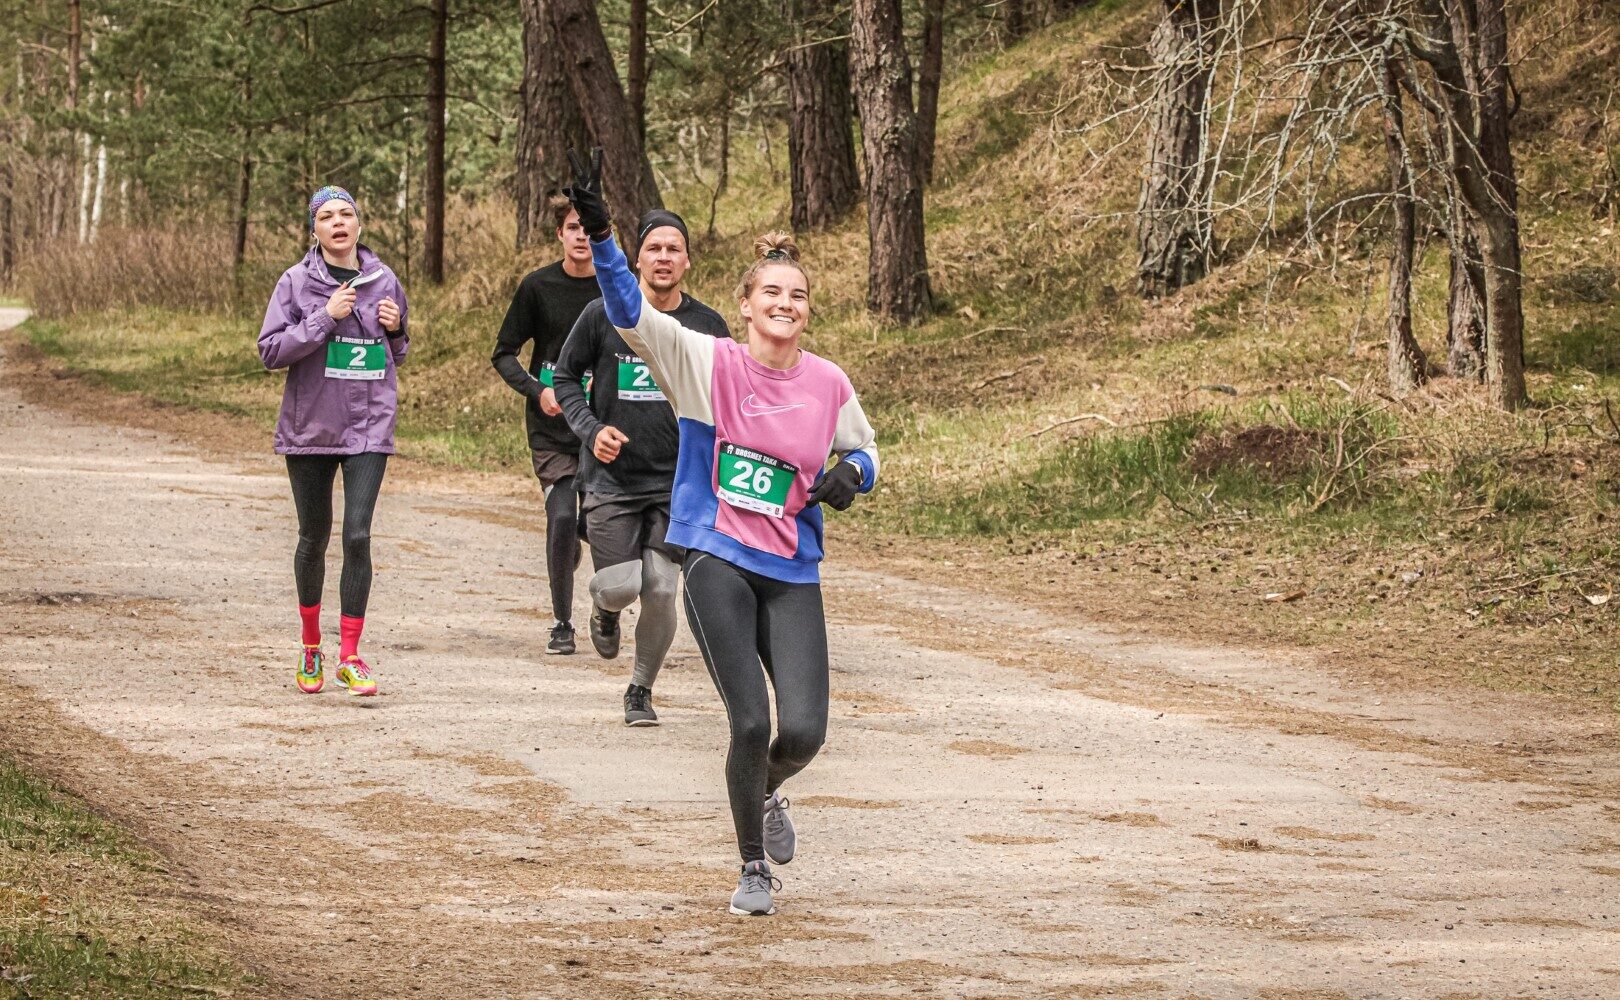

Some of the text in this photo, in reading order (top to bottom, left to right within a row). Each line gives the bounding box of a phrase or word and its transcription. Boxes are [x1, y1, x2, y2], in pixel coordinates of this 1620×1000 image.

[349, 346, 367, 367] 2
[735, 448, 778, 467] DROSMES TAKA
[729, 460, 774, 495] 26
